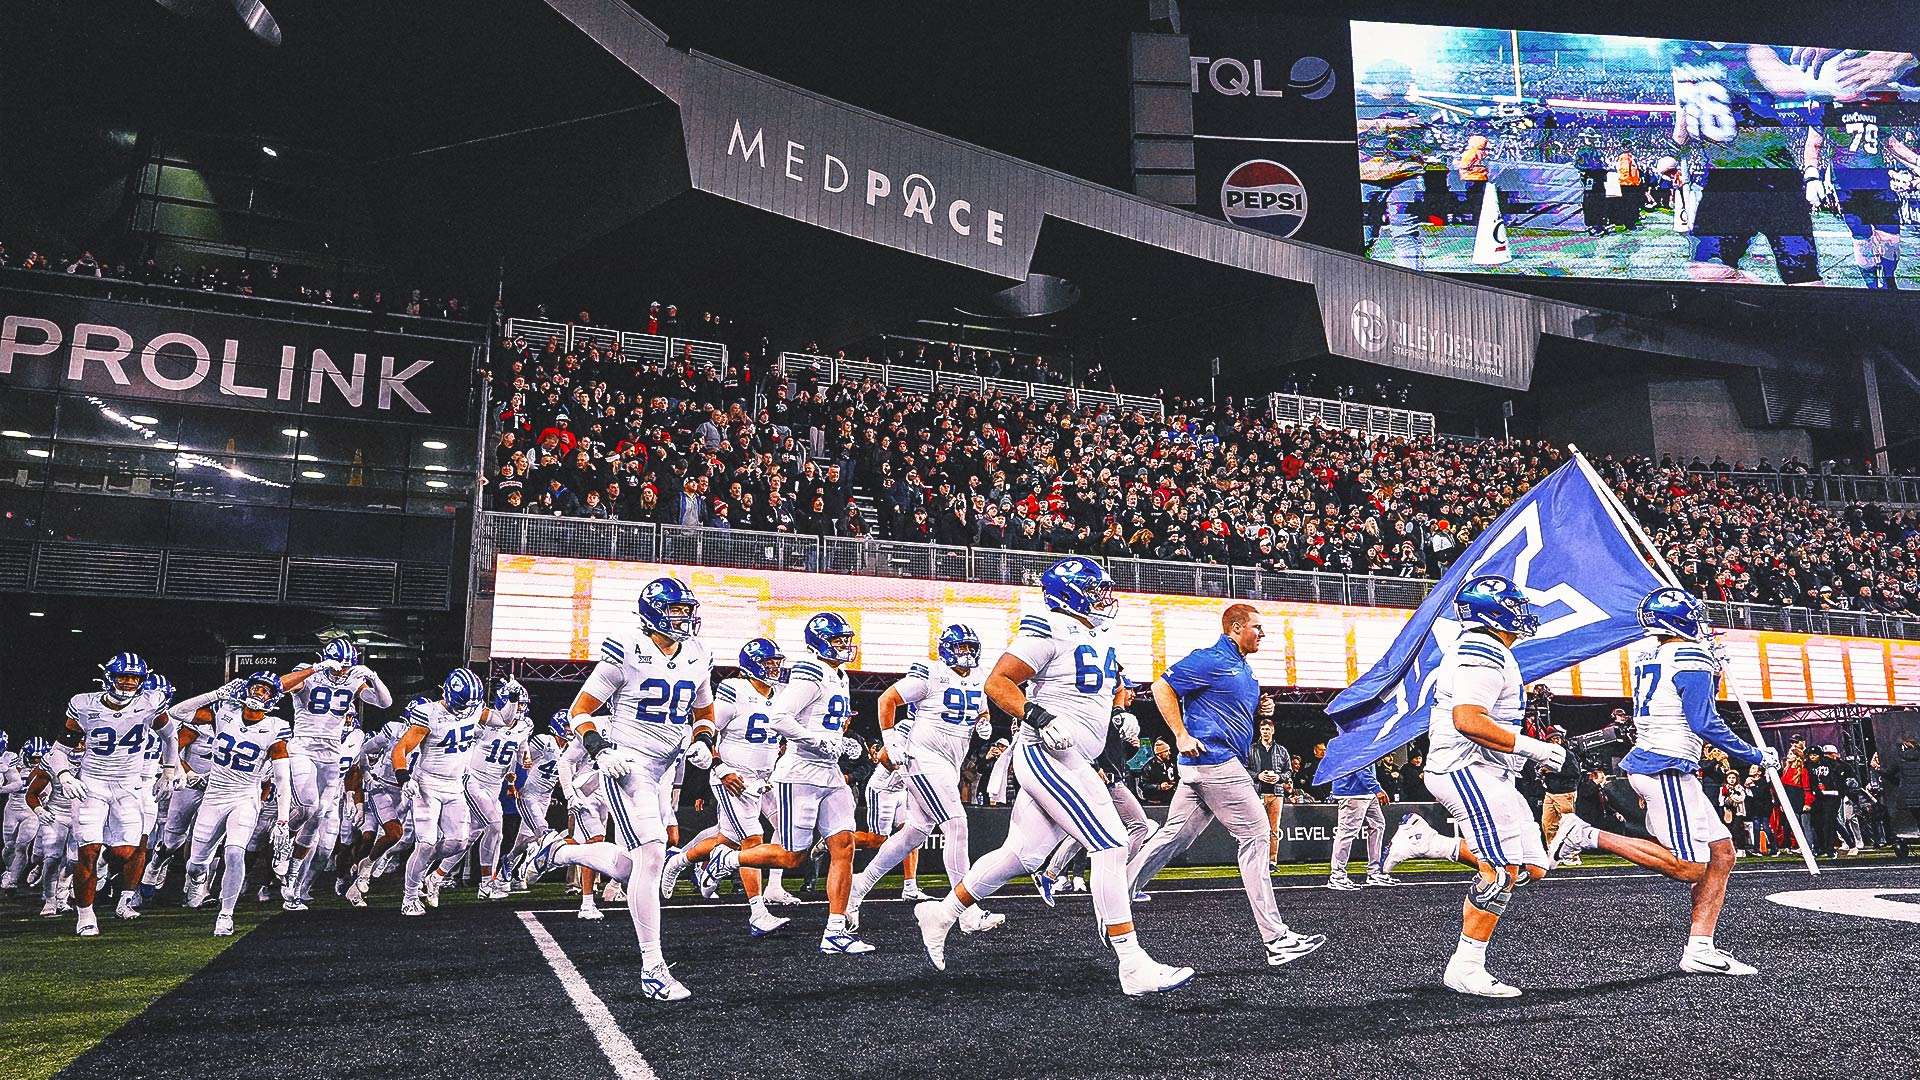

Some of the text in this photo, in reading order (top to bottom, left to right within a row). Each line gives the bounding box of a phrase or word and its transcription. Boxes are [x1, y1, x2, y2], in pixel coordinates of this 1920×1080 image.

[1189, 56, 1283, 97] TQL
[727, 118, 1004, 247] MEDPACE
[1225, 190, 1303, 212] PEPSI
[0, 315, 434, 414] PROLINK
[1073, 644, 1119, 695] 64
[307, 685, 357, 717] 83
[635, 677, 697, 725] 20
[940, 687, 982, 726] 95
[90, 723, 146, 757] 34
[213, 731, 262, 773] 32
[436, 723, 475, 755] 45
[485, 738, 519, 766] 16
[1286, 826, 1331, 841] LEVEL
